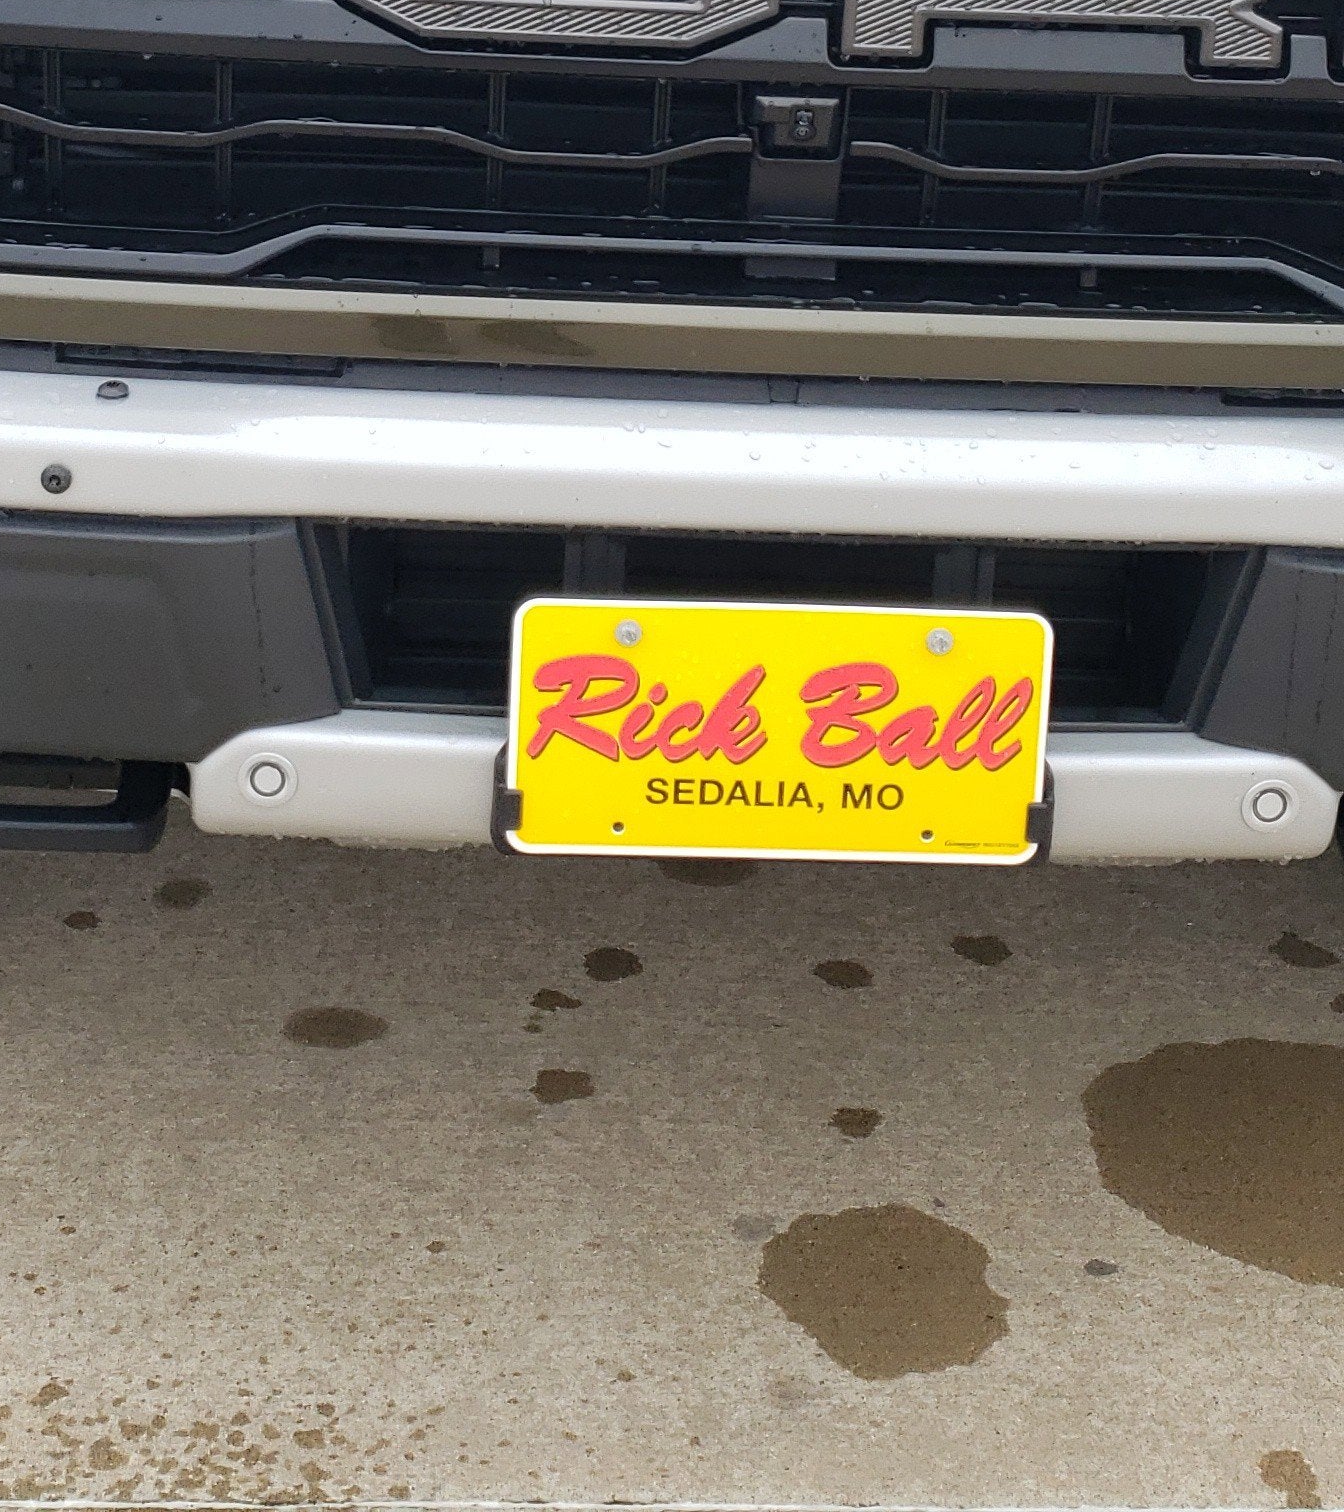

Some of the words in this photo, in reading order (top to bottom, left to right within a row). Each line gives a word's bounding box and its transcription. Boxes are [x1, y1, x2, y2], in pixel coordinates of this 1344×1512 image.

[526, 654, 767, 763] Rick
[799, 662, 1033, 772] Ball
[645, 777, 825, 813] SEDALIA,
[840, 782, 905, 811] MO
